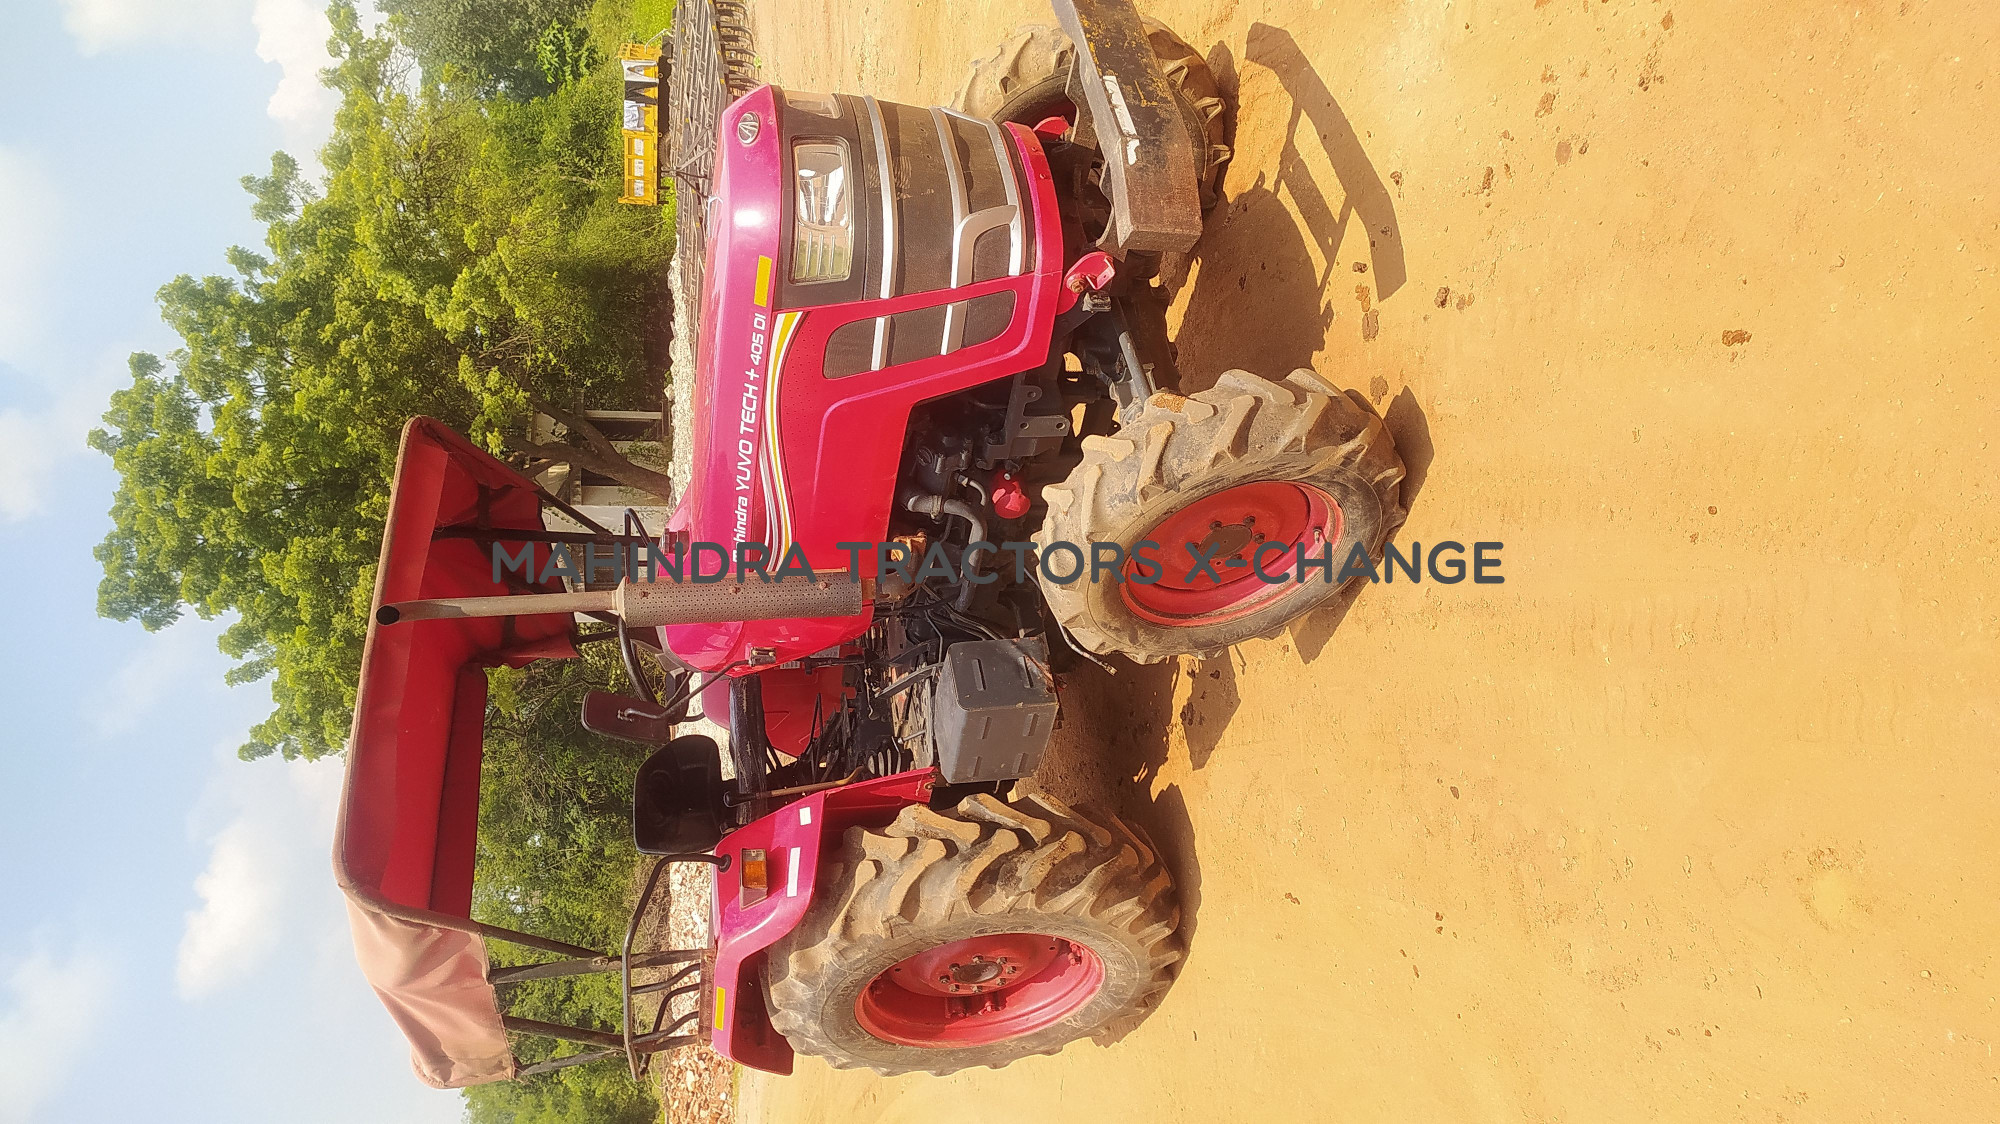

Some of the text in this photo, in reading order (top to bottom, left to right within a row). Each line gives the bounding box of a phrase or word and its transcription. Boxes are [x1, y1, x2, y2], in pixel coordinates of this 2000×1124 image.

[732, 313, 767, 563] hindra YUVO TECH + 405 DI
